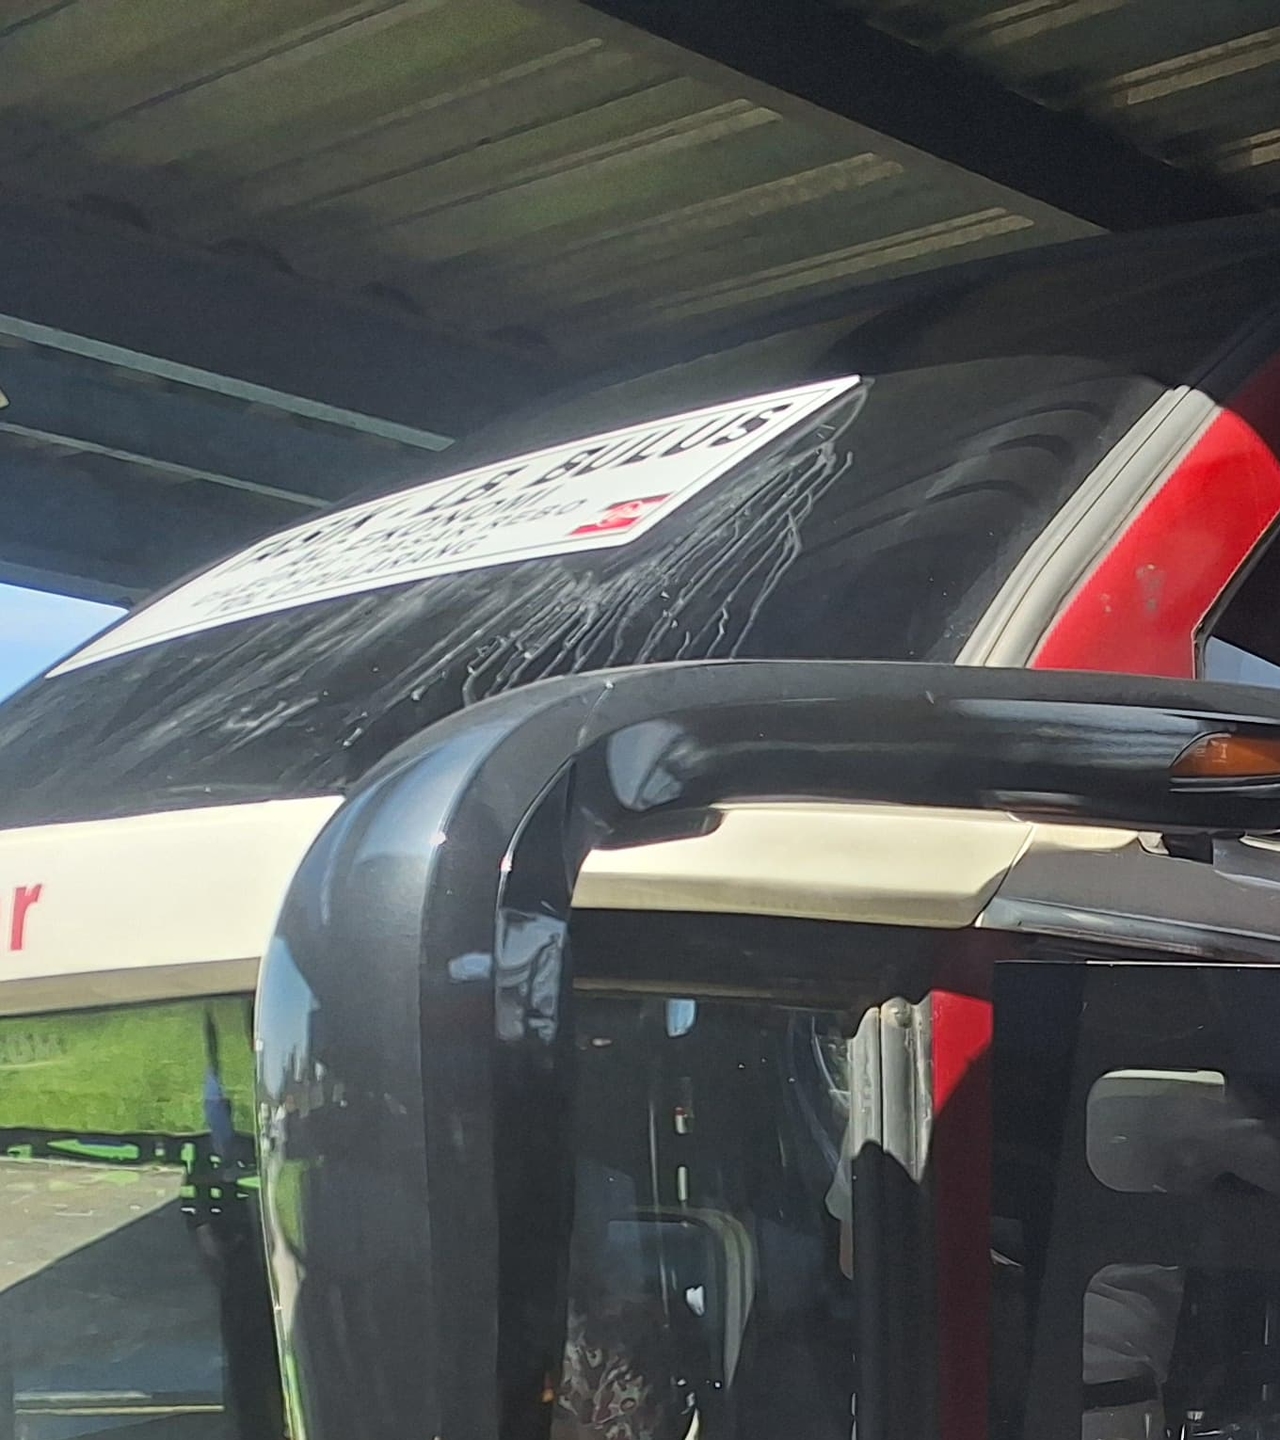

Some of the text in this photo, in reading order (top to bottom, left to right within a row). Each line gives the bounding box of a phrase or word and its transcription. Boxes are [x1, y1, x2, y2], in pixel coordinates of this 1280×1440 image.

[524, 401, 797, 488] BULUS
[339, 483, 568, 554] EKONOMI
[354, 520, 483, 563] PASAR
[473, 497, 592, 534] REBO
[258, 533, 494, 602] CIPULARANG
